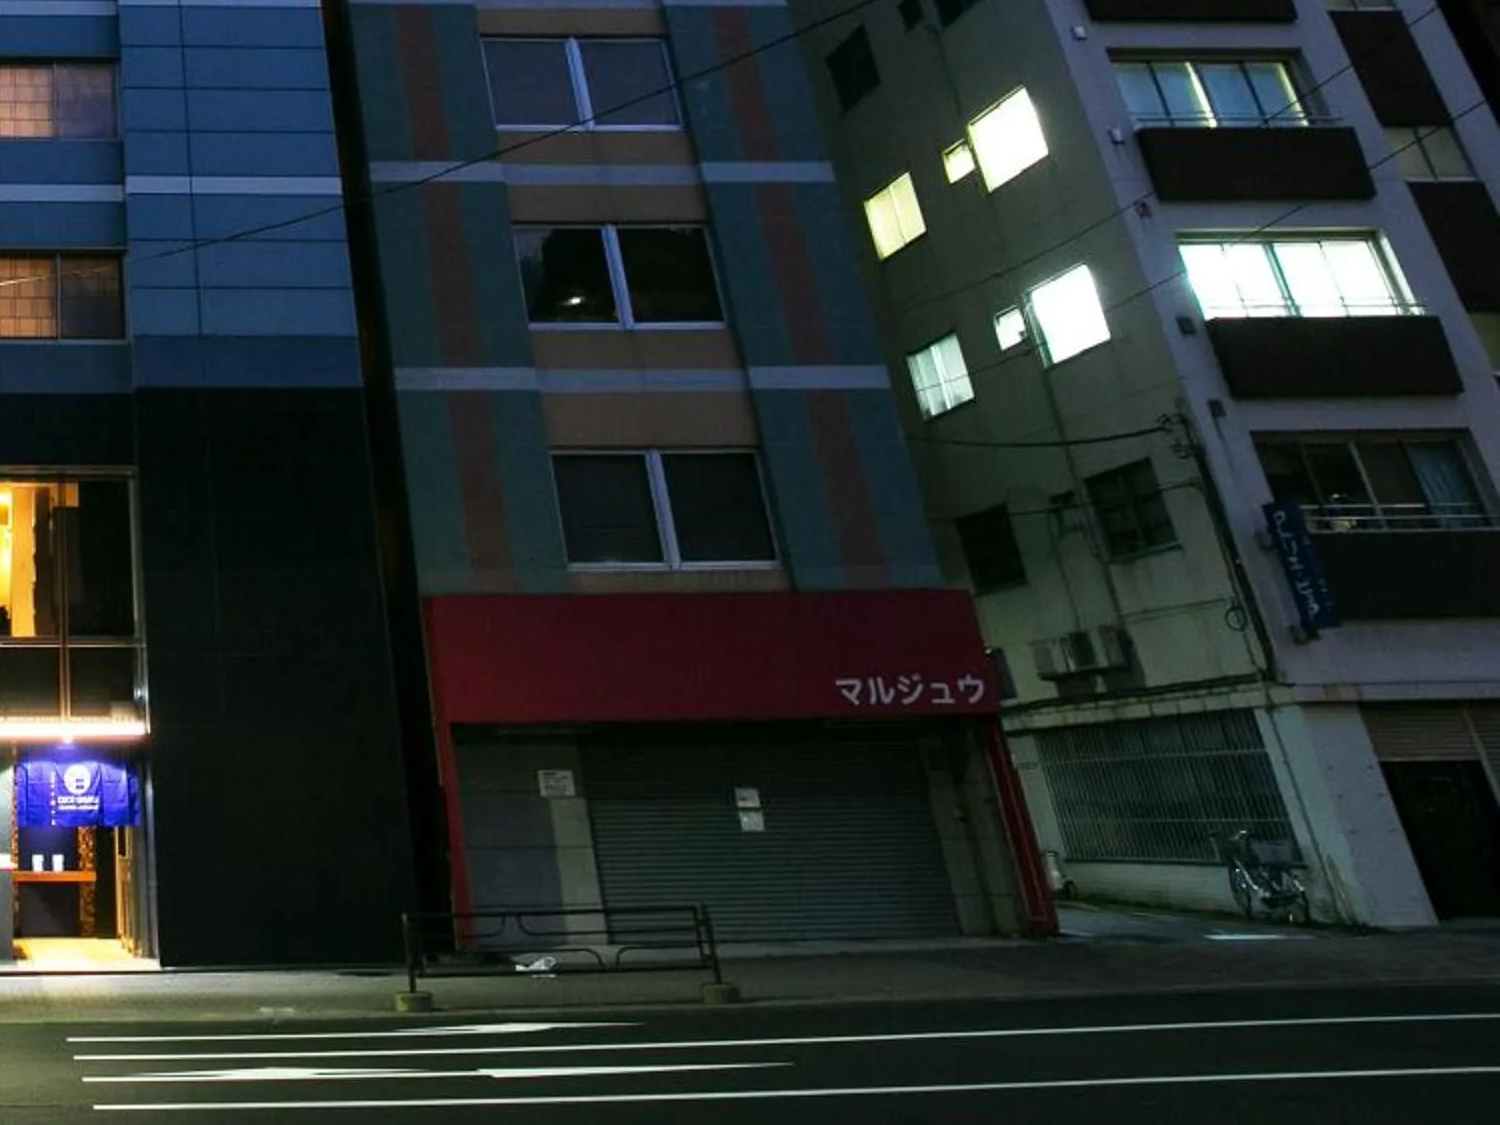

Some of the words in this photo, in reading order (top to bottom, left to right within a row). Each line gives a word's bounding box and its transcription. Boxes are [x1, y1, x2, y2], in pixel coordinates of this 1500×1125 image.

[835, 673, 985, 706] マルジュウ
